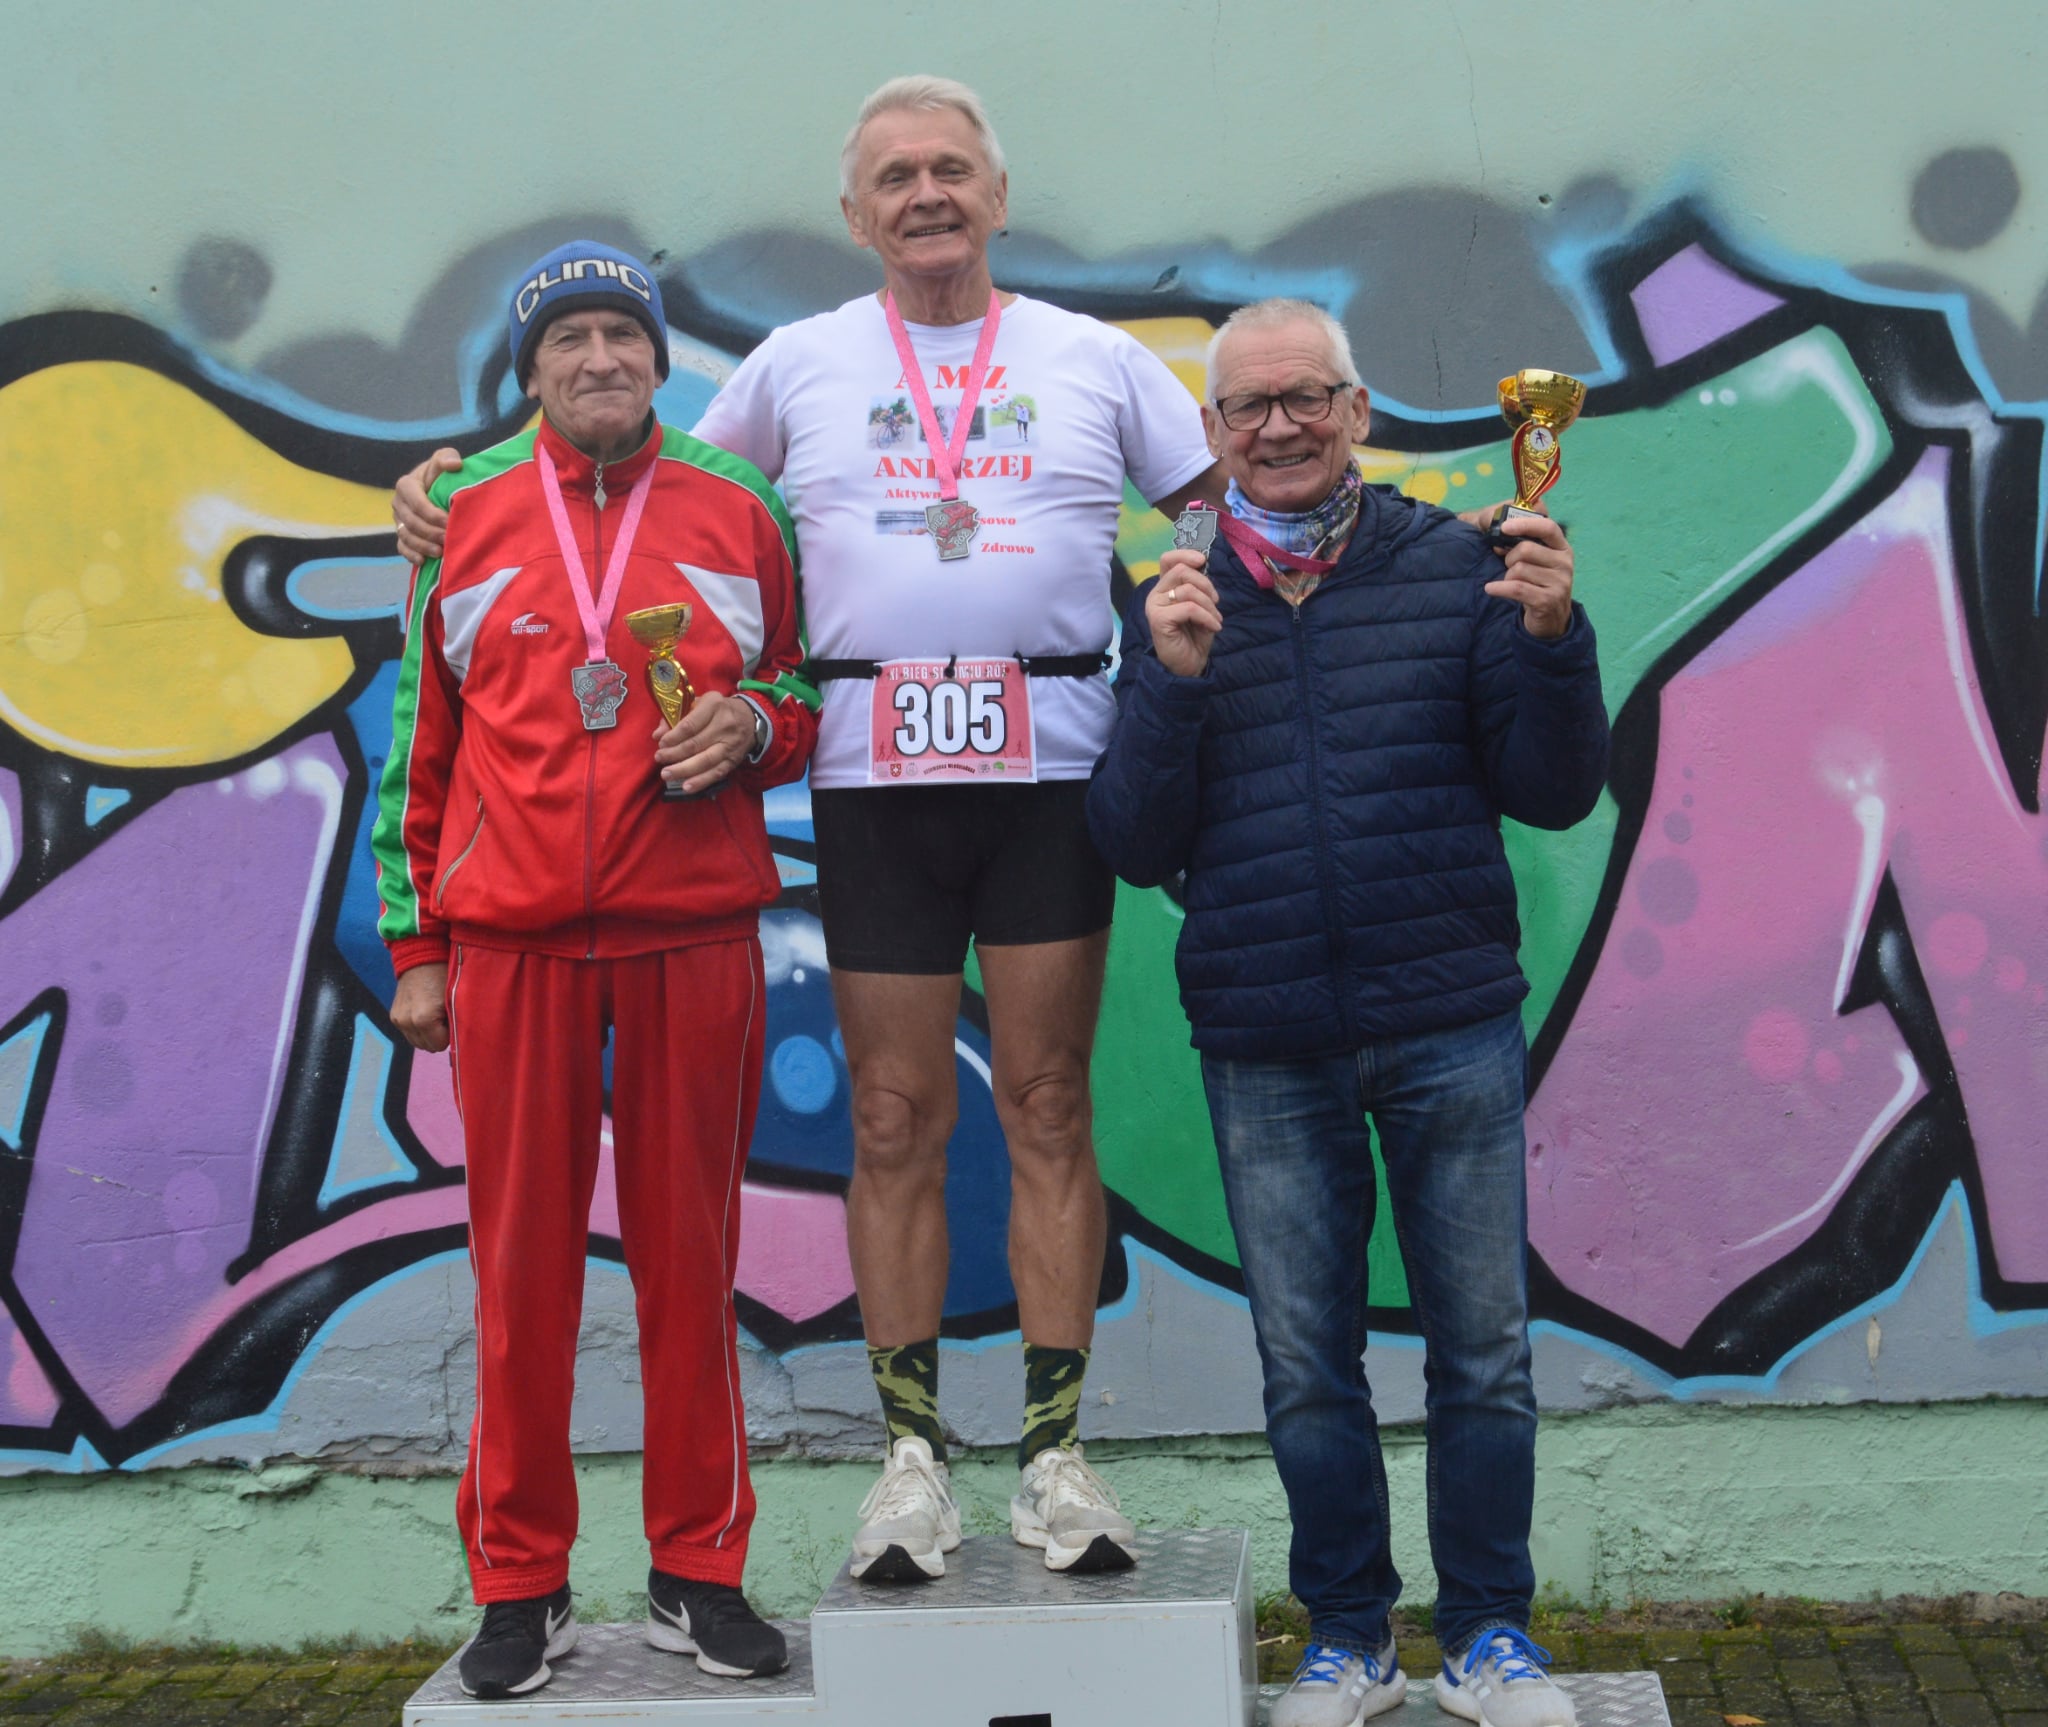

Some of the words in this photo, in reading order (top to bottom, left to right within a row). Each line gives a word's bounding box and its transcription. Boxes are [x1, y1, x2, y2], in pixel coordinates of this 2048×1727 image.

[516, 259, 650, 323] CLINIC
[885, 488, 942, 501] Aktywn
[979, 516, 1017, 526] sowo
[981, 541, 1035, 554] Zdrowo
[903, 665, 928, 680] BIEG
[893, 681, 1007, 757] 305
